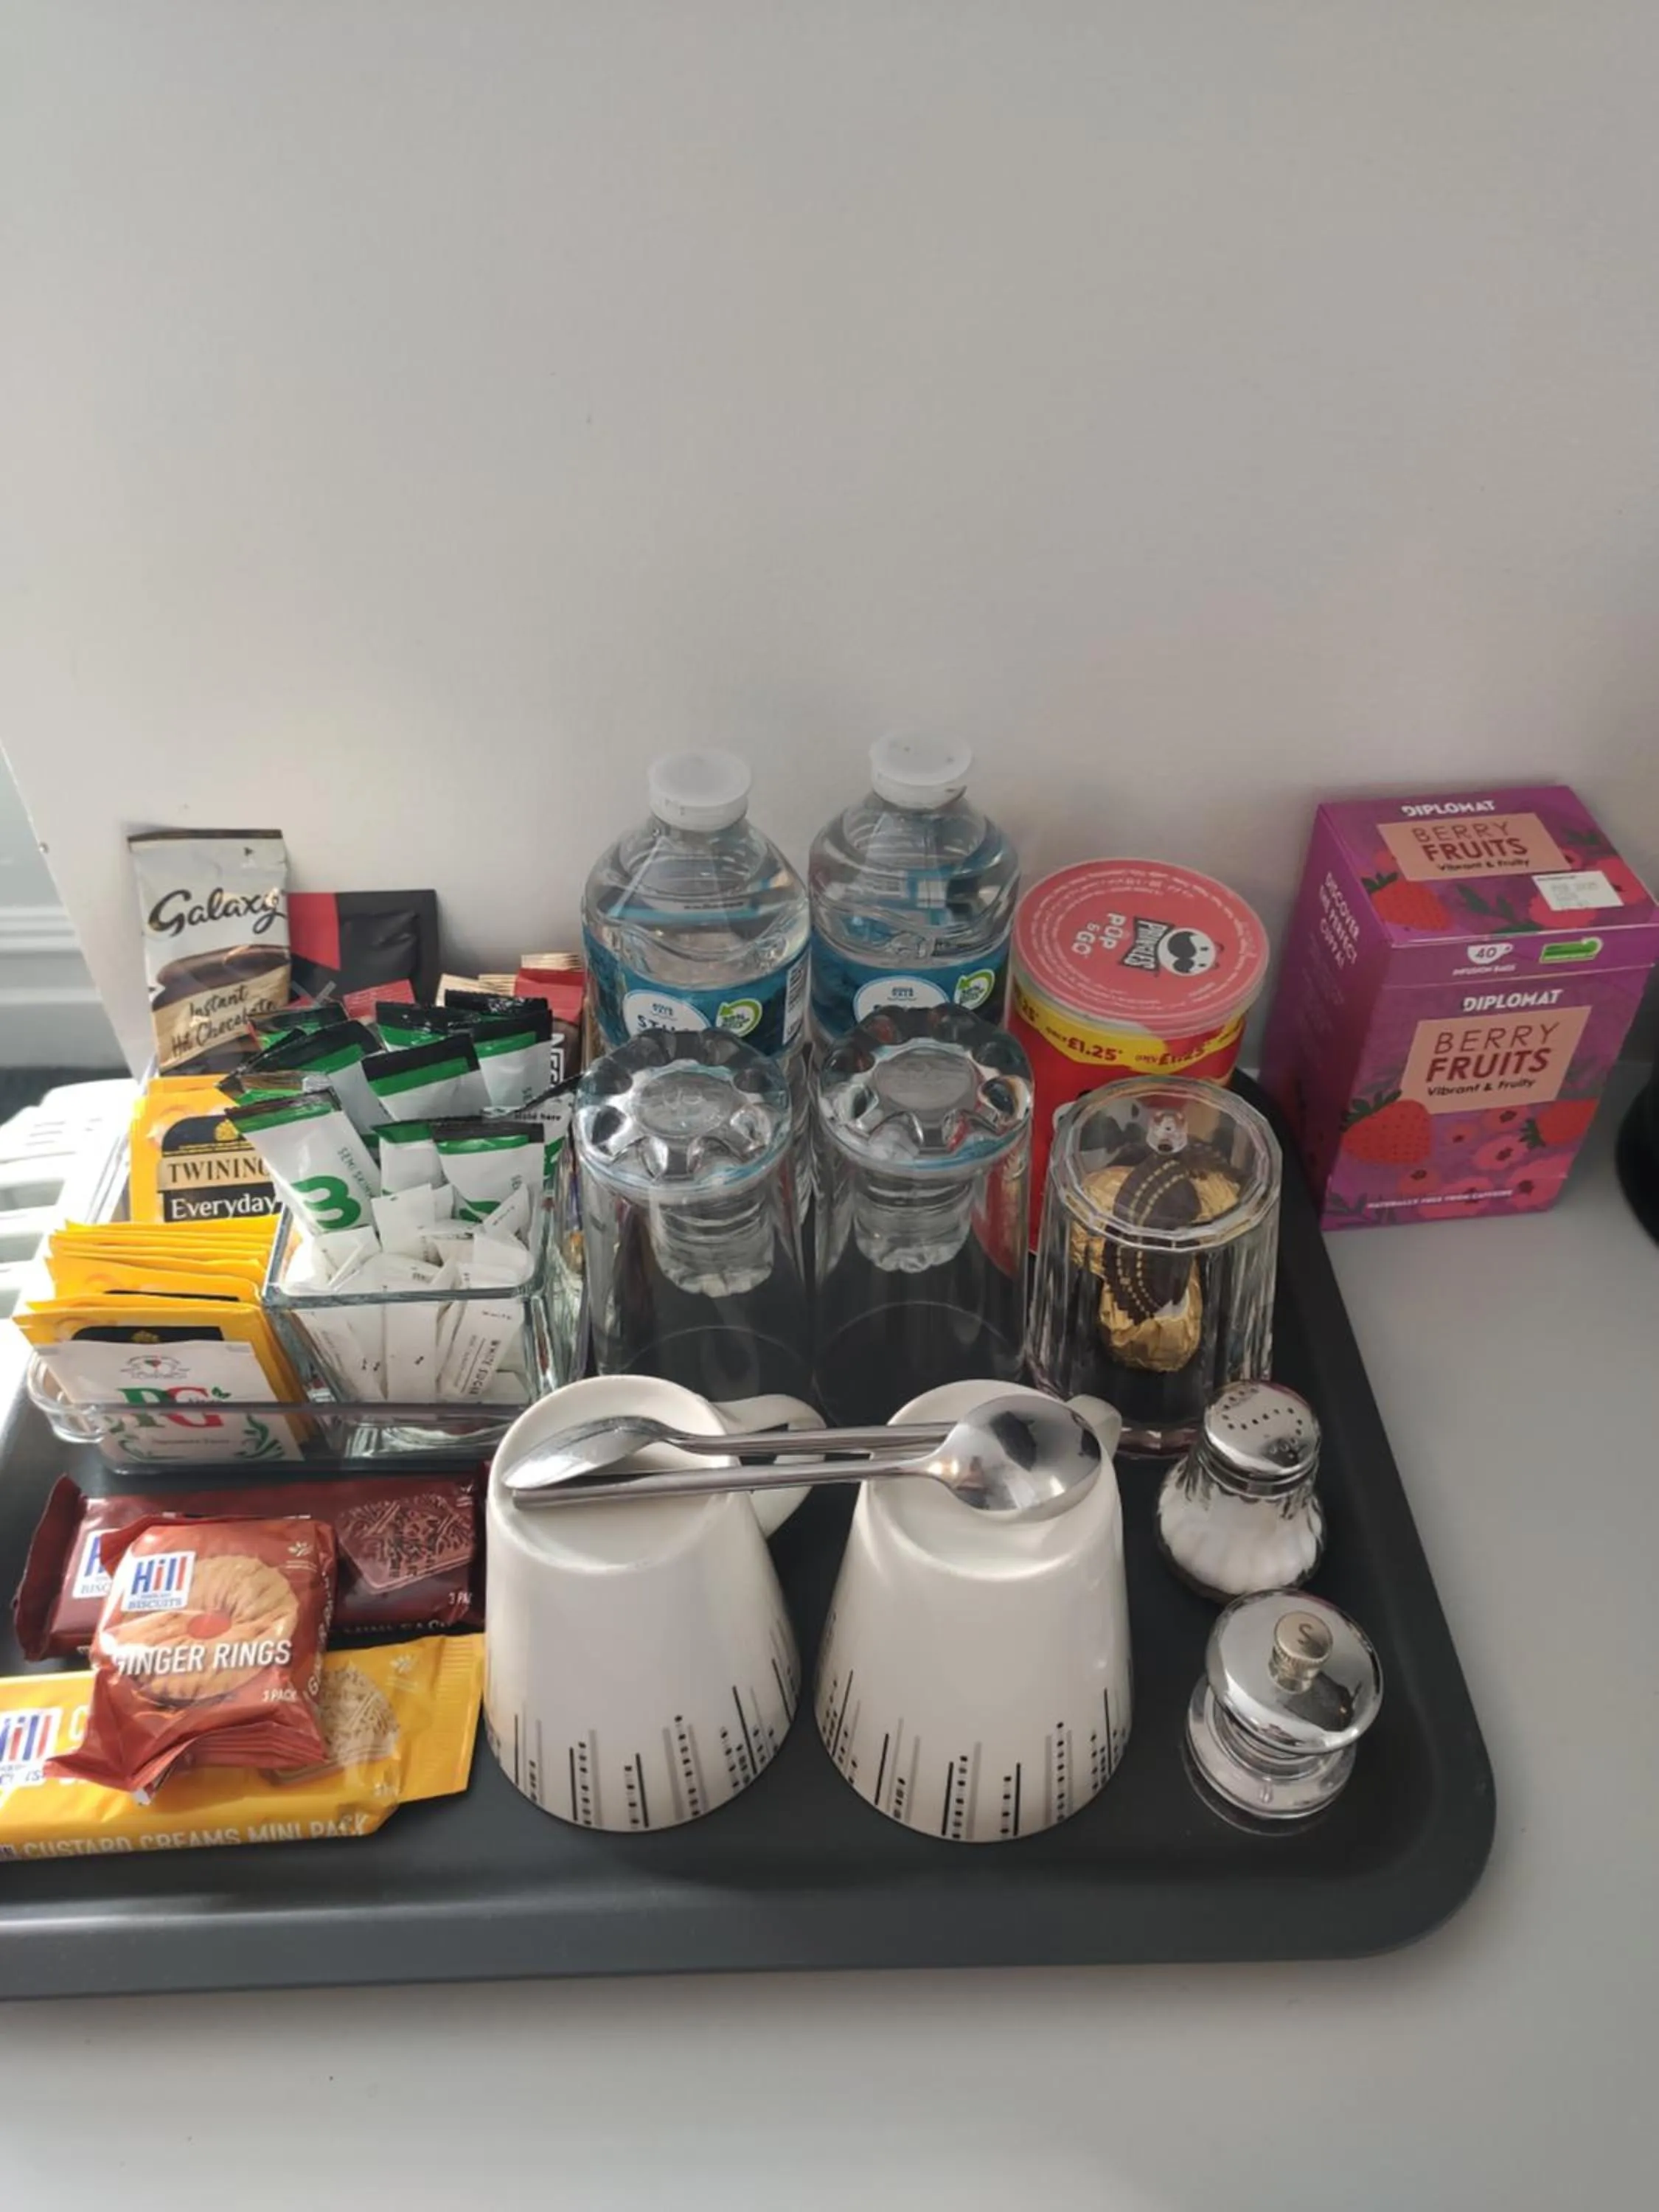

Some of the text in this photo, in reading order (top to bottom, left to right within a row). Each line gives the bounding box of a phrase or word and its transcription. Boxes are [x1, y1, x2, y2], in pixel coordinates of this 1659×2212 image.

[1401, 799, 1496, 817] DIPLOMAT
[1411, 821, 1509, 843] BERRY
[1422, 837, 1528, 862] FRUITS
[148, 887, 287, 936] Galaxy
[1098, 912, 1127, 950] POP
[1475, 947, 1497, 959] 40
[189, 984, 248, 1018] Instant
[1462, 990, 1564, 1012] DIPLOMAT
[1434, 1022, 1560, 1054] BERRY
[1425, 1048, 1552, 1083] FRUITS
[1427, 1085, 1481, 1096] Vibrant
[1483, 1082, 1493, 1091] &
[167, 1155, 271, 1183] TWININ
[171, 1192, 278, 1220] Everyday
[131, 1556, 187, 1596] Hill
[128, 1598, 182, 1610] BISCUITS
[212, 1640, 293, 1669] RINGS
[24, 1835, 133, 1859] CUSTARD
[139, 1829, 241, 1851] CREAMS
[247, 1822, 303, 1843] MINI
[309, 1812, 369, 1837] PACK
